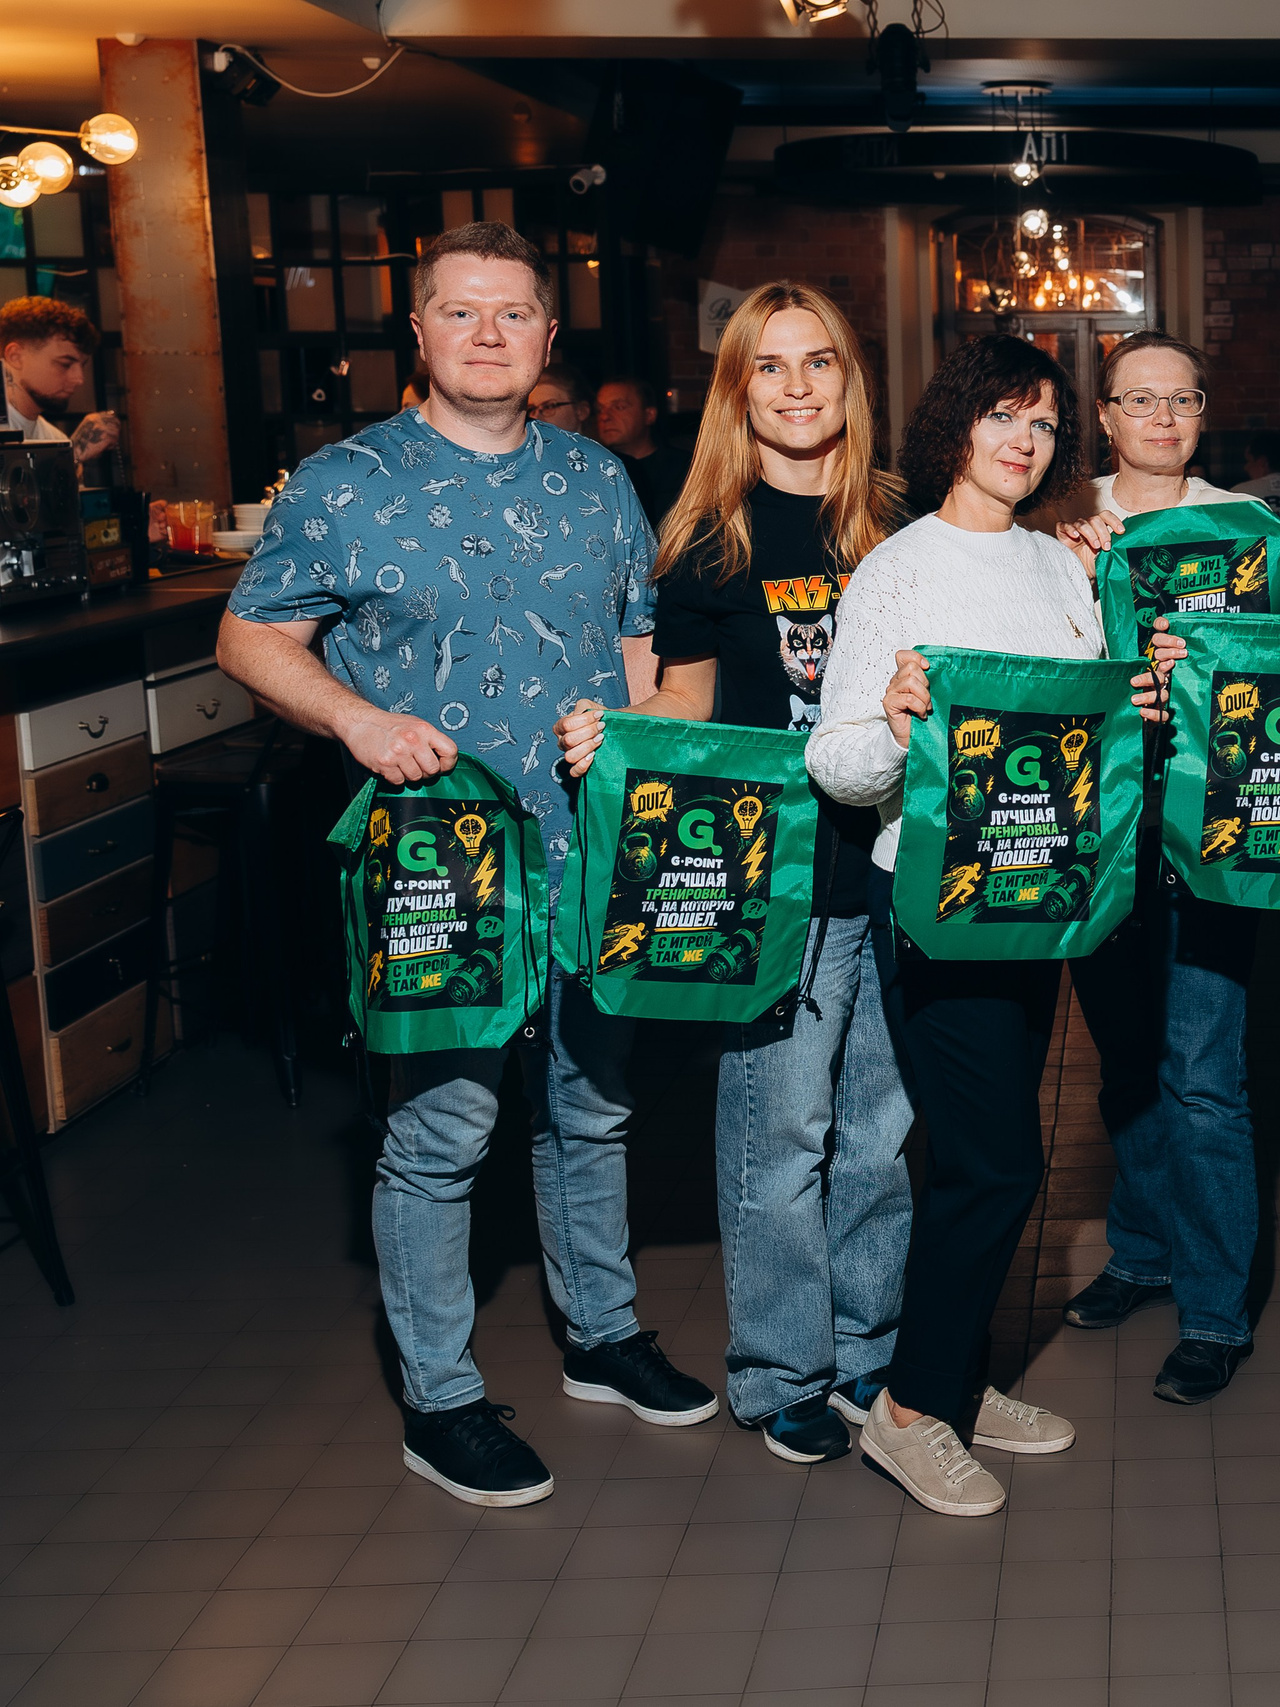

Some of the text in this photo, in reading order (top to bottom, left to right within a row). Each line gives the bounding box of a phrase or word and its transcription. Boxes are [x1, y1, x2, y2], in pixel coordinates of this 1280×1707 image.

[1180, 558, 1221, 576] ТАК ЖЕ
[1175, 574, 1210, 593] ИГРОЙ
[1255, 796, 1270, 806] НА
[990, 807, 1056, 826] ЛУЧШАЯ
[980, 824, 1059, 840] ТРЕНИРОВКА
[997, 839, 1011, 850] НА
[1014, 835, 1069, 849] КОТОРУЮ
[1253, 843, 1277, 855] ТАК
[658, 872, 727, 888] ЛУЧШАЯ
[1005, 870, 1049, 888] ИГРОЙ
[646, 888, 727, 900] ТРЕНИРОВКА
[992, 887, 1040, 903] ТАК ЖЕ
[386, 893, 456, 913] ЛУЧШАЯ
[662, 900, 677, 912] НА
[680, 900, 735, 912] КОТОРУЮ
[390, 927, 406, 938] НА
[410, 921, 467, 937] КОТОРУЮ
[670, 933, 713, 949] ИГРОЙ
[655, 949, 704, 963] ТАК ЖЕ
[406, 955, 450, 976] ИГРОЙ
[393, 973, 442, 992] ТАК ЖЕ
